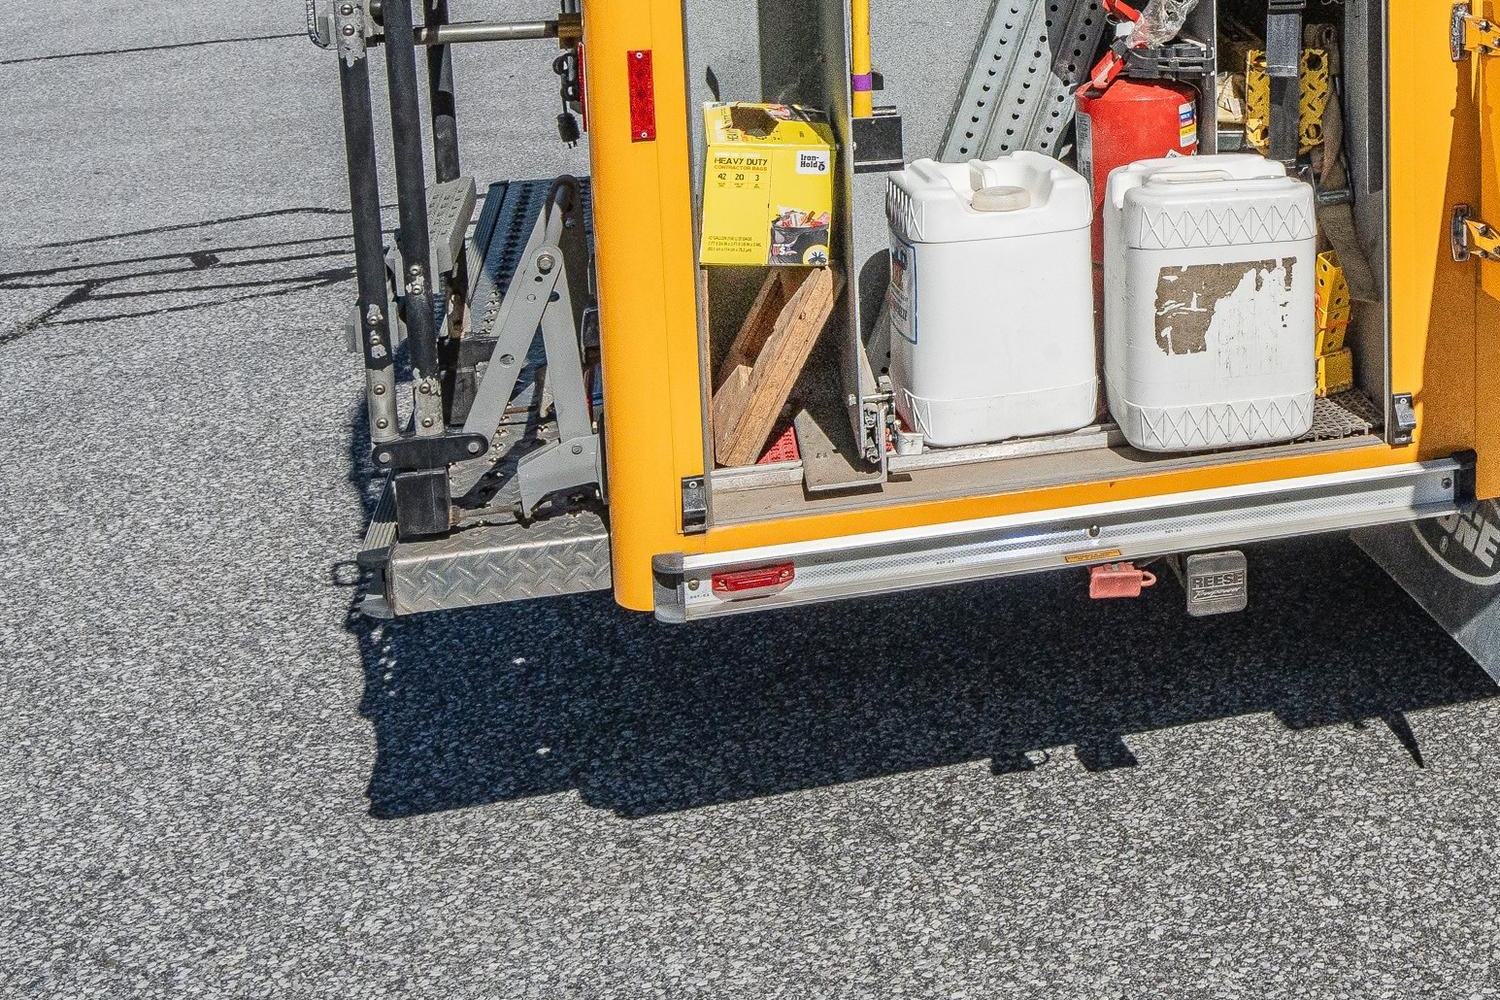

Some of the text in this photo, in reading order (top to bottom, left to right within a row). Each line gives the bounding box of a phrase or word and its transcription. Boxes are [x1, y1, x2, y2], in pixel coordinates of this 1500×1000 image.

[714, 157, 768, 166] HEAVY DUTY
[1192, 572, 1243, 588] REESE
